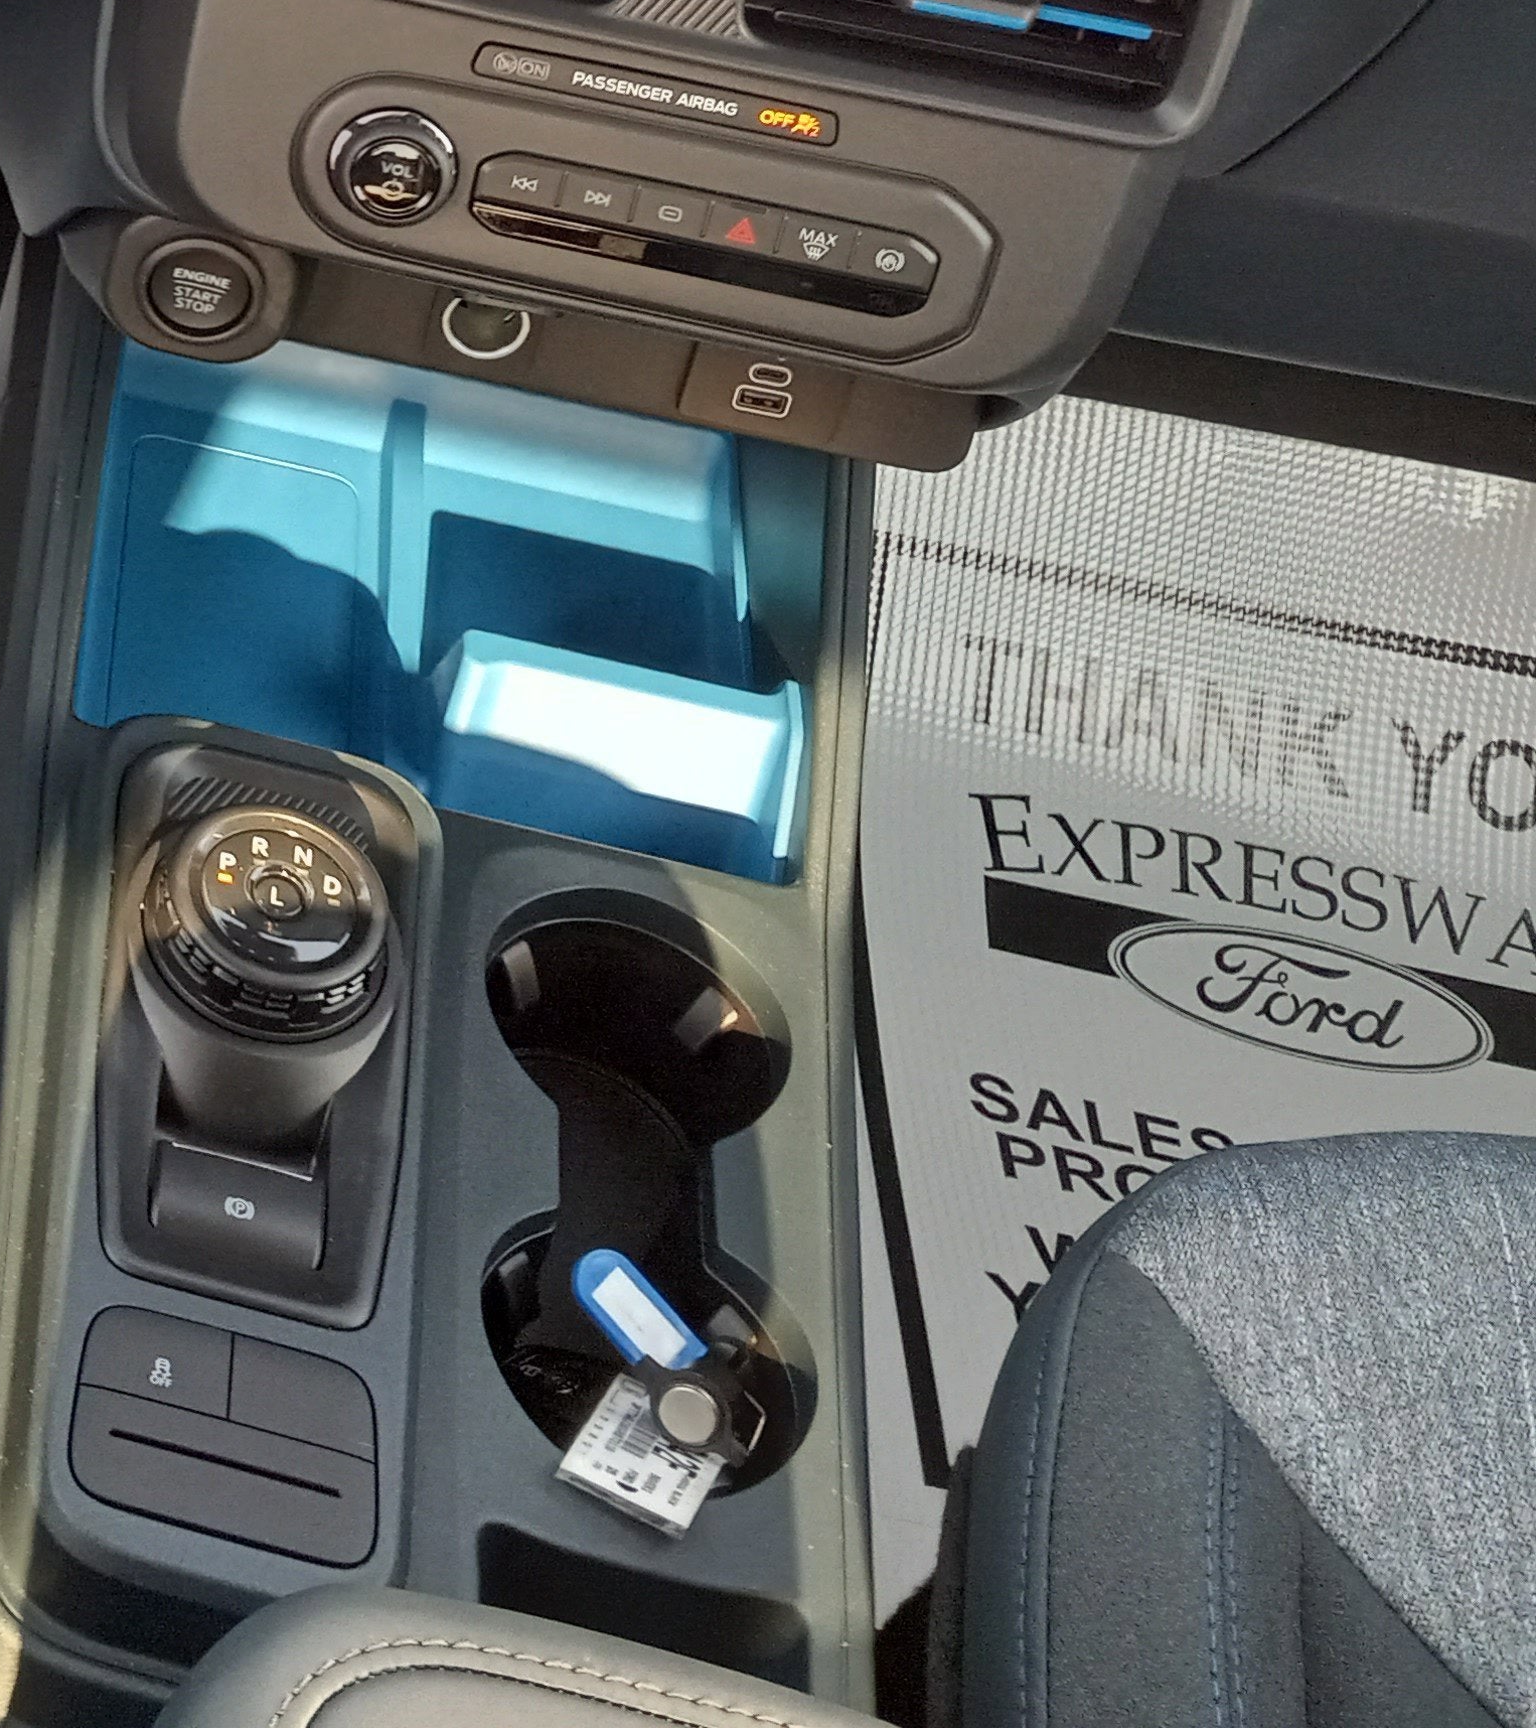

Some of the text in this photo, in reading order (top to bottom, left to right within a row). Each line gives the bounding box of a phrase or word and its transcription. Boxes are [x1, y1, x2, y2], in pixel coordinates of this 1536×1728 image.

[525, 63, 547, 77] ON
[572, 71, 673, 103] PASSENGER
[676, 93, 738, 116] AIRBAG
[758, 109, 794, 128] OFF
[381, 160, 414, 178] VOL
[798, 228, 839, 247] MAX
[172, 267, 232, 290] ENGINE
[173, 285, 222, 305] START
[174, 297, 215, 314] STOP
[965, 632, 1351, 799] THANK
[251, 835, 269, 858] R
[293, 845, 313, 867] N
[218, 851, 237, 871] P
[270, 885, 285, 907] L
[323, 874, 341, 896] D
[1197, 943, 1405, 1050] Ford
